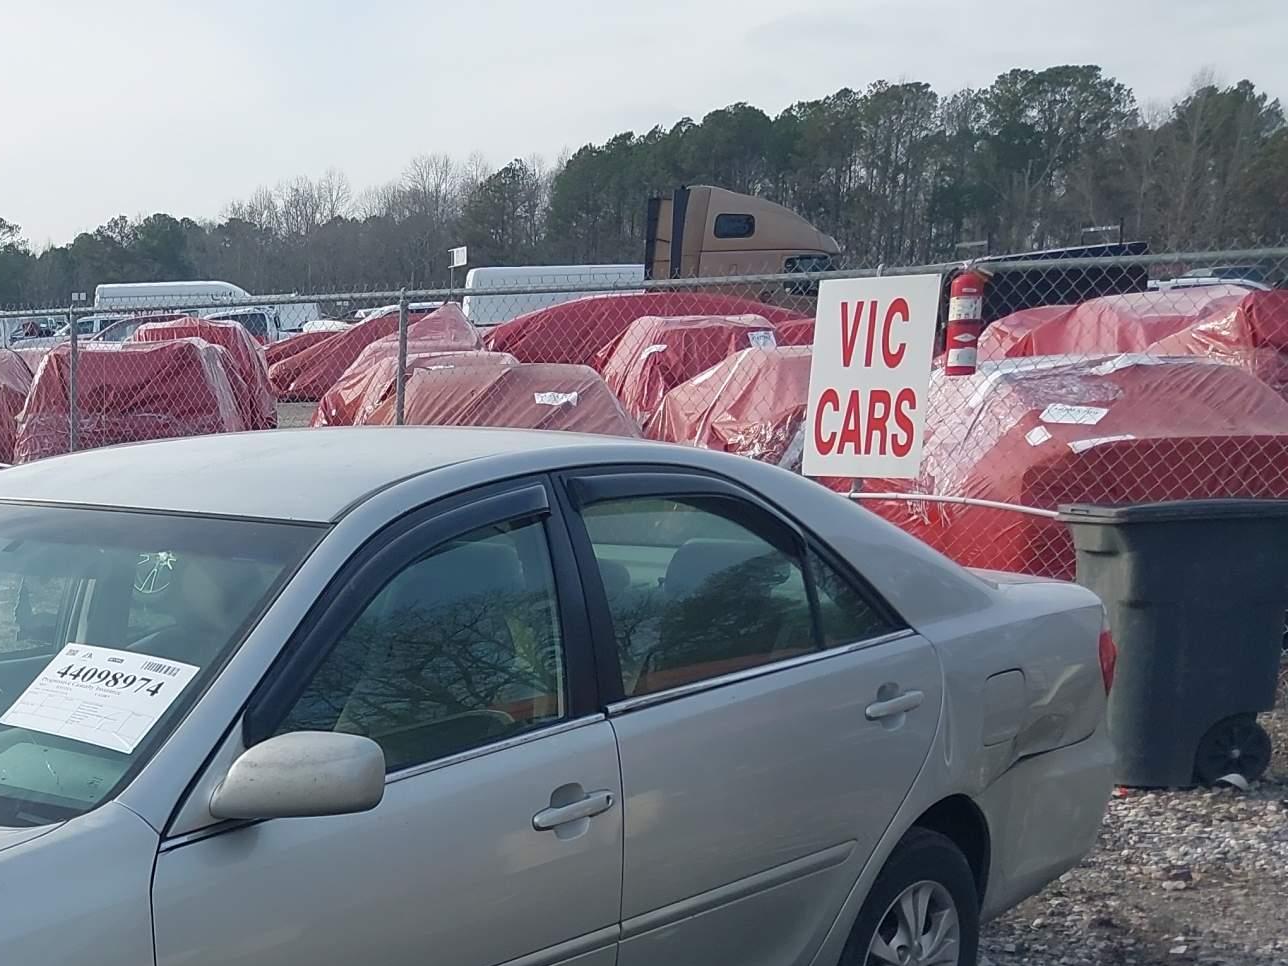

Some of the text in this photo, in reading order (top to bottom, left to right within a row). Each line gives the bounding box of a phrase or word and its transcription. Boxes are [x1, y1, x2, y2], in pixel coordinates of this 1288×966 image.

[840, 297, 910, 369] VIC
[814, 387, 917, 458] CARS
[56, 663, 165, 697] 44098974
